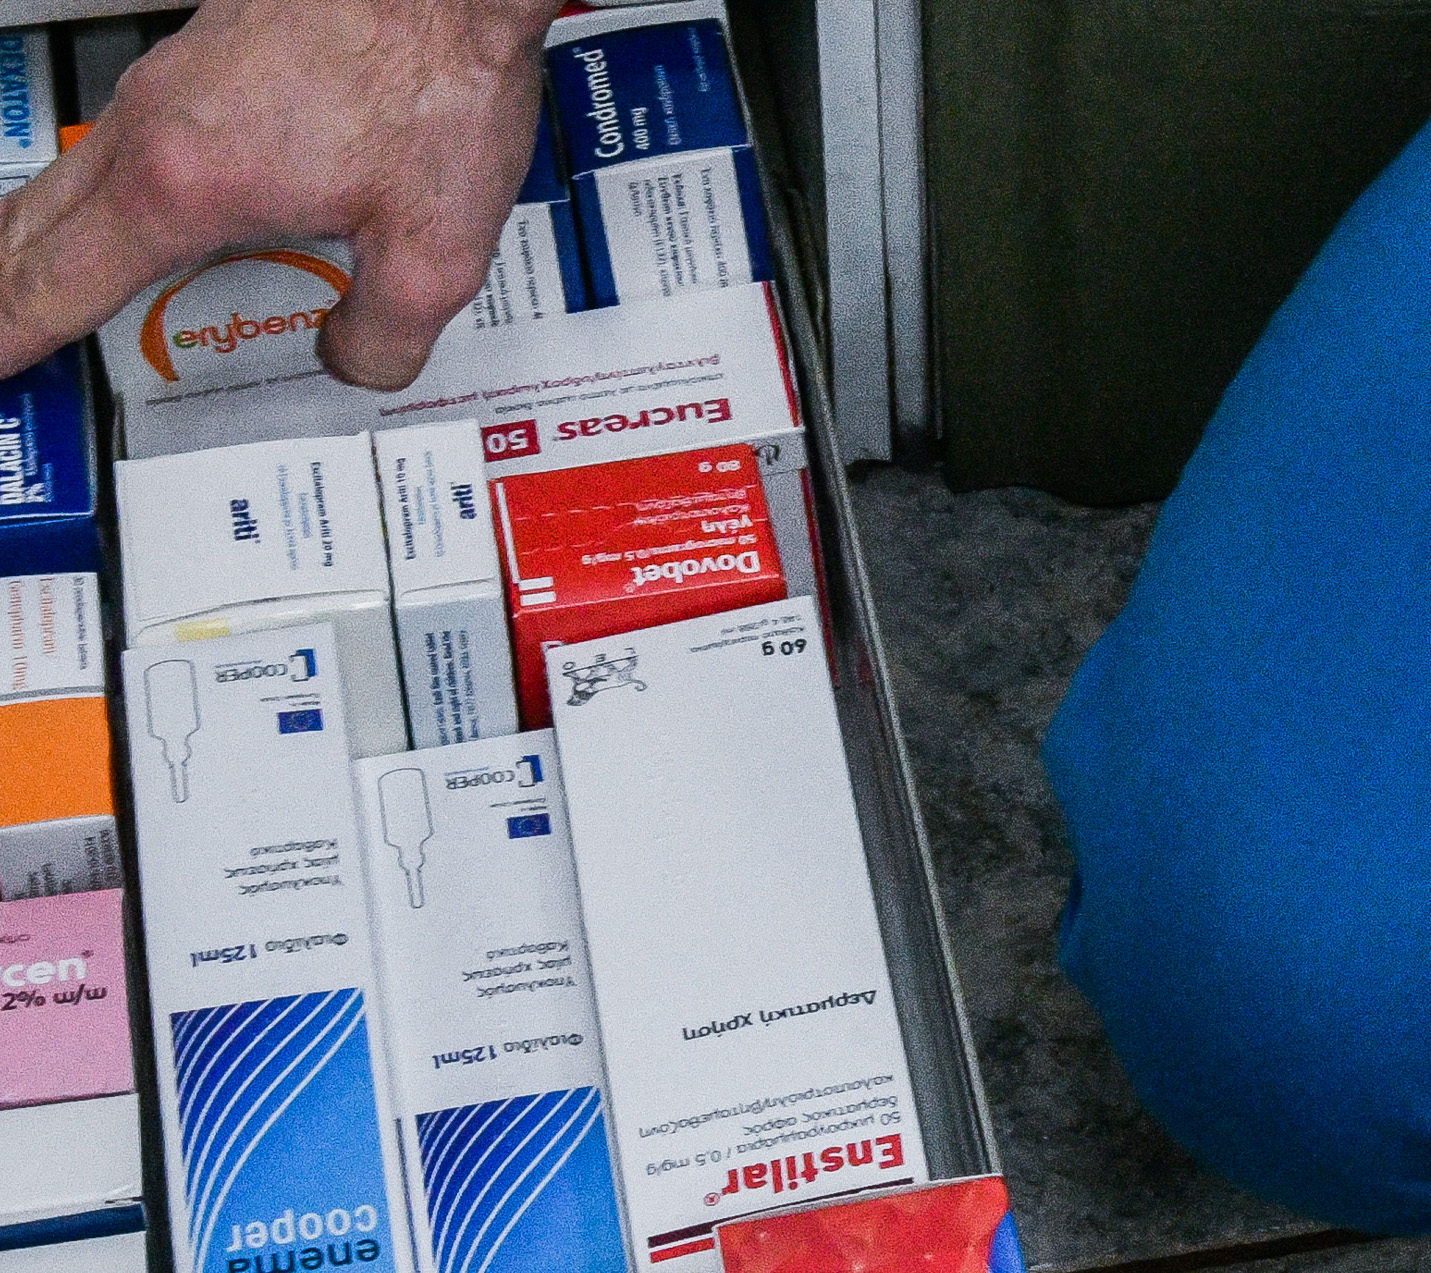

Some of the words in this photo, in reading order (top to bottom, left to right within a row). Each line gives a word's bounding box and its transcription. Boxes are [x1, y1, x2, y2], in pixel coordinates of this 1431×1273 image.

[576, 48, 622, 159] Condromed
[631, 106, 647, 126] mg
[633, 128, 649, 149] 400
[557, 398, 732, 441] Eucreas
[486, 428, 528, 454] 50
[453, 484, 475, 519] ariti
[230, 499, 259, 541] ariti
[701, 514, 753, 534] γέλη
[632, 550, 761, 587] Dovobet
[780, 638, 807, 656] 60
[215, 664, 288, 683] COOPER
[445, 770, 515, 791] COOPER
[190, 944, 258, 968] 125ml
[1, 990, 46, 1011] 2%
[52, 983, 108, 1006] w/w
[759, 989, 877, 1024] Δερματική
[682, 1013, 753, 1040] χρήση
[503, 1032, 584, 1054] Φιαλίδιο
[432, 1045, 497, 1070] 125ml
[880, 1110, 902, 1126] 50
[721, 1133, 904, 1196] Enstilar
[226, 1204, 378, 1252] cooper
